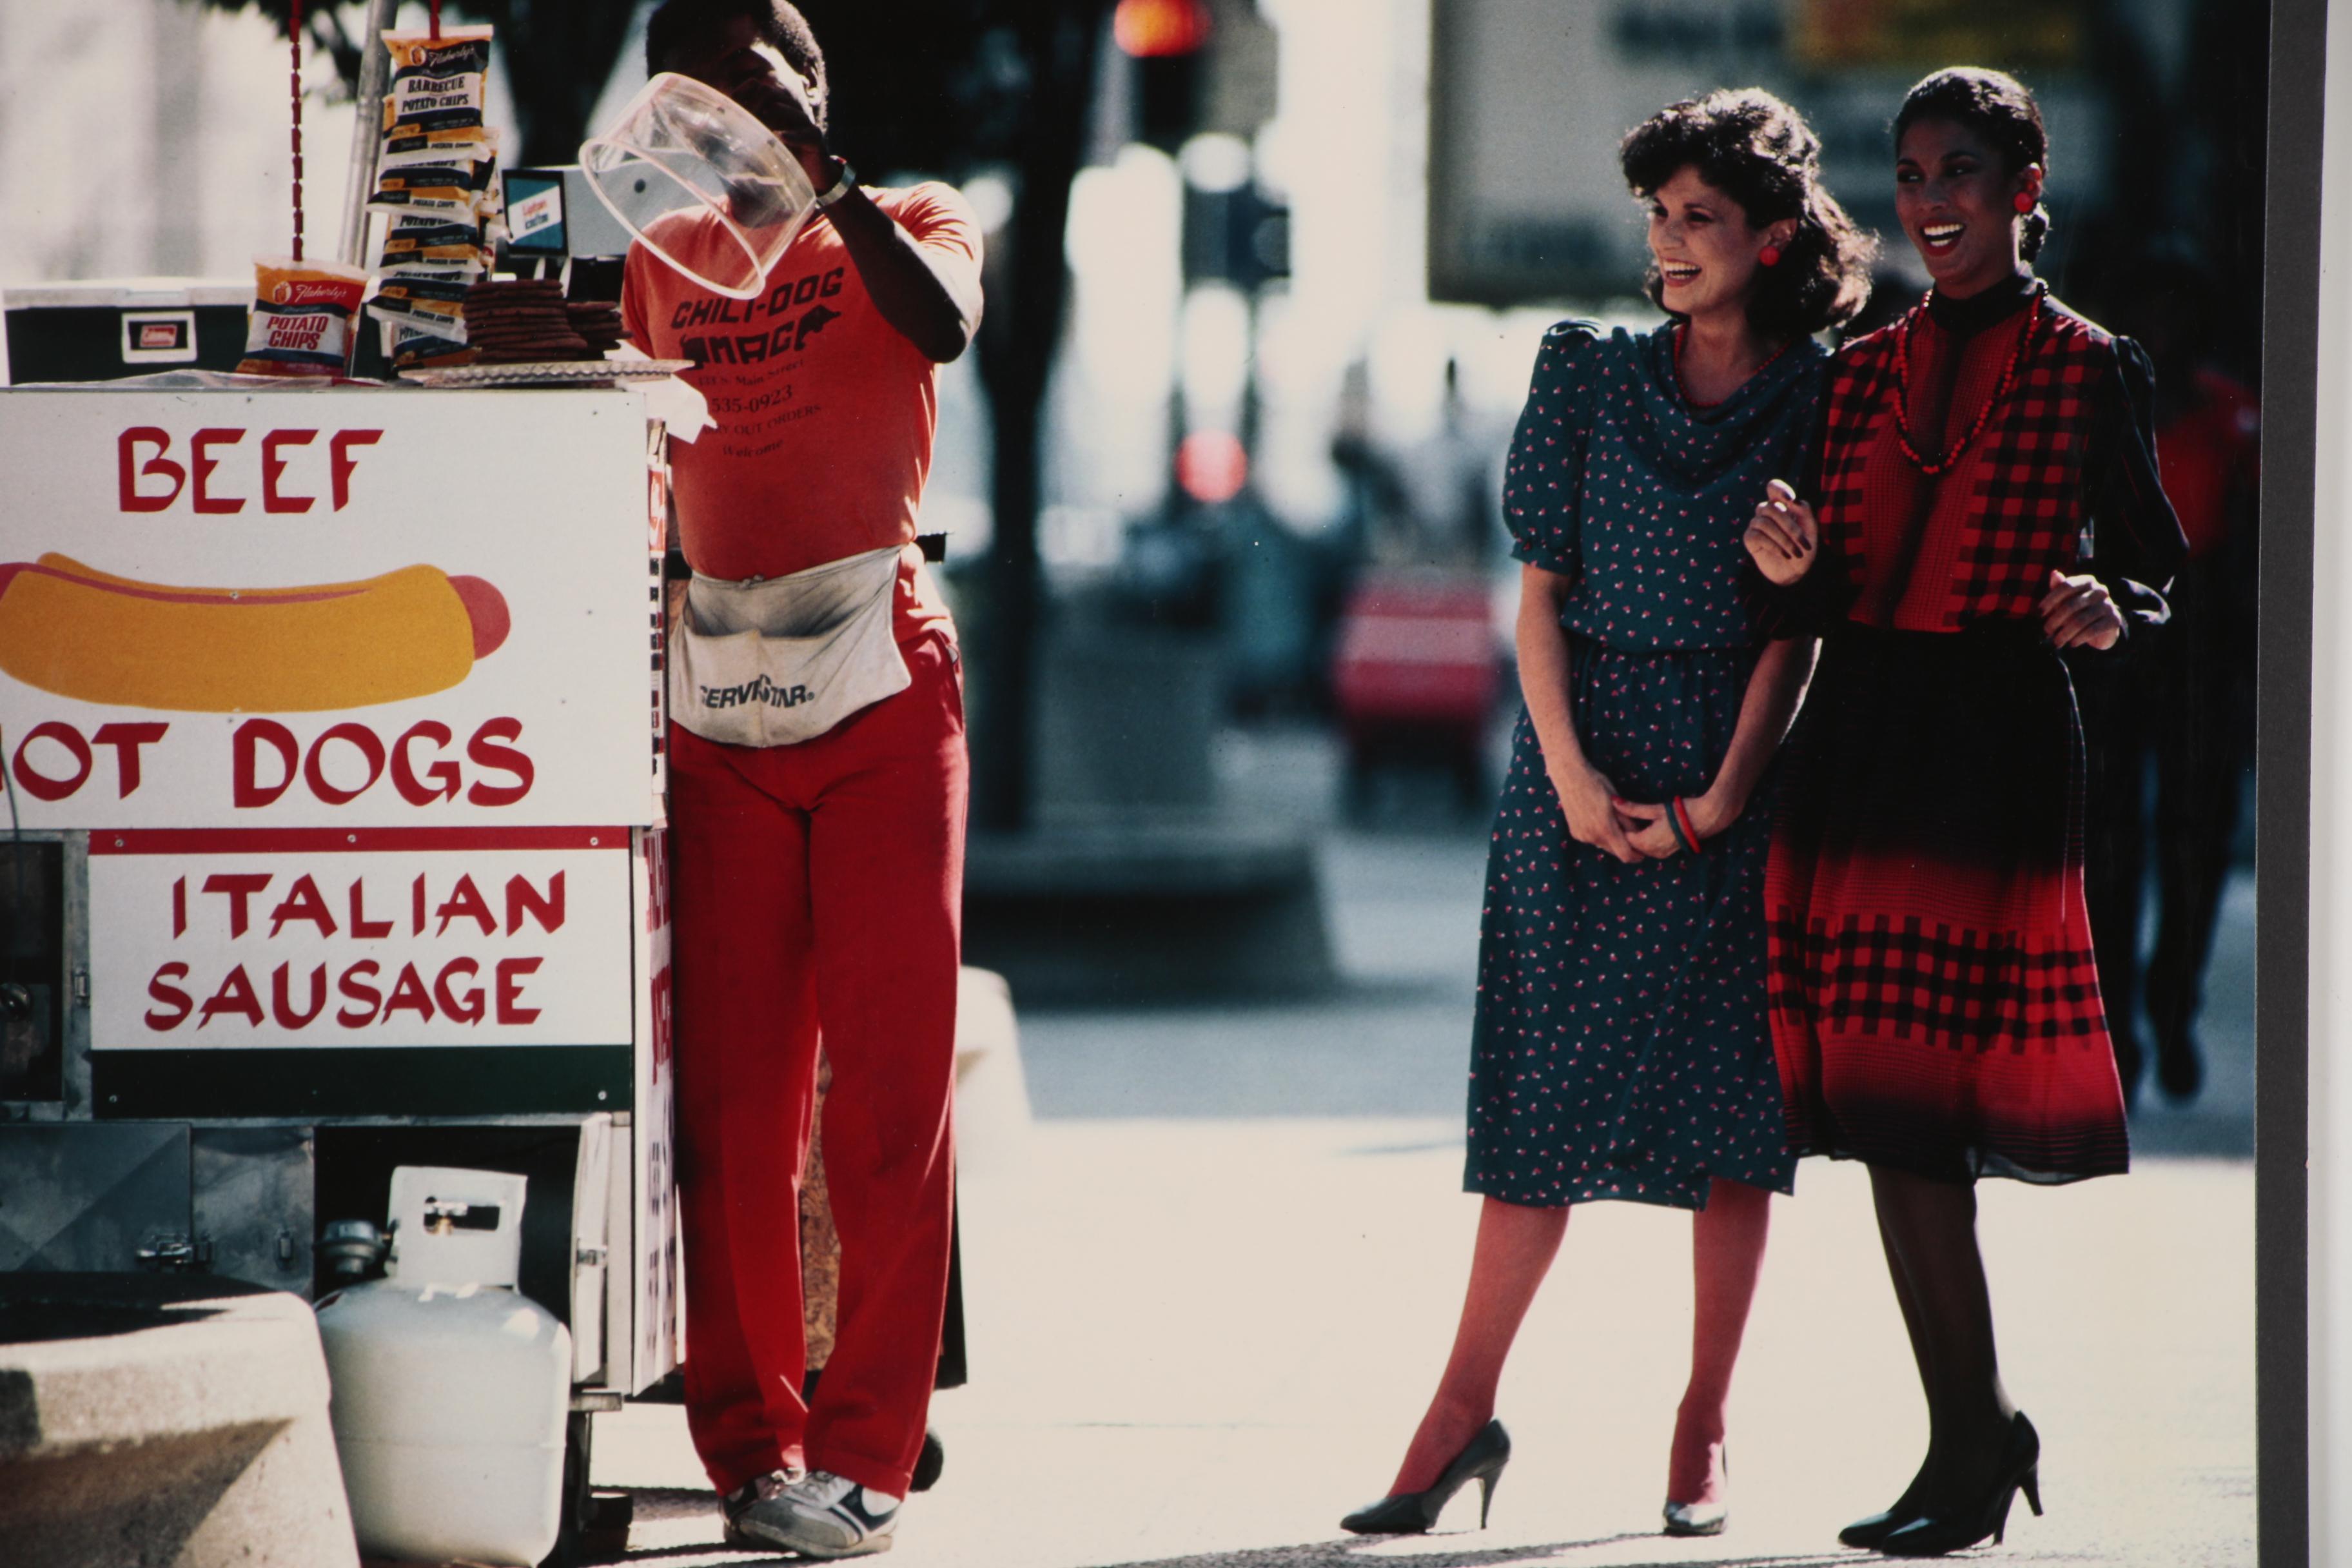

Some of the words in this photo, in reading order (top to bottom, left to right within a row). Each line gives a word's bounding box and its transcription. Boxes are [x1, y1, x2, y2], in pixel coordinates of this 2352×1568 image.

[407, 76, 466, 93] BARBECUE
[402, 97, 437, 113] POTATO
[440, 93, 469, 106] CHIPS
[671, 267, 844, 329] CHILI-DOG
[267, 315, 329, 333] POTATO
[268, 330, 320, 350] CHIPS
[736, 375, 764, 386] Main
[711, 384, 793, 413] 535-0923
[734, 423, 763, 436] OUT
[767, 404, 822, 429] ORDERS
[118, 426, 384, 514] BEEF
[0, 721, 170, 801] OT
[233, 716, 535, 808] DOGS
[172, 869, 565, 941] ITALIAN
[144, 956, 545, 1032] SAUSAGE
